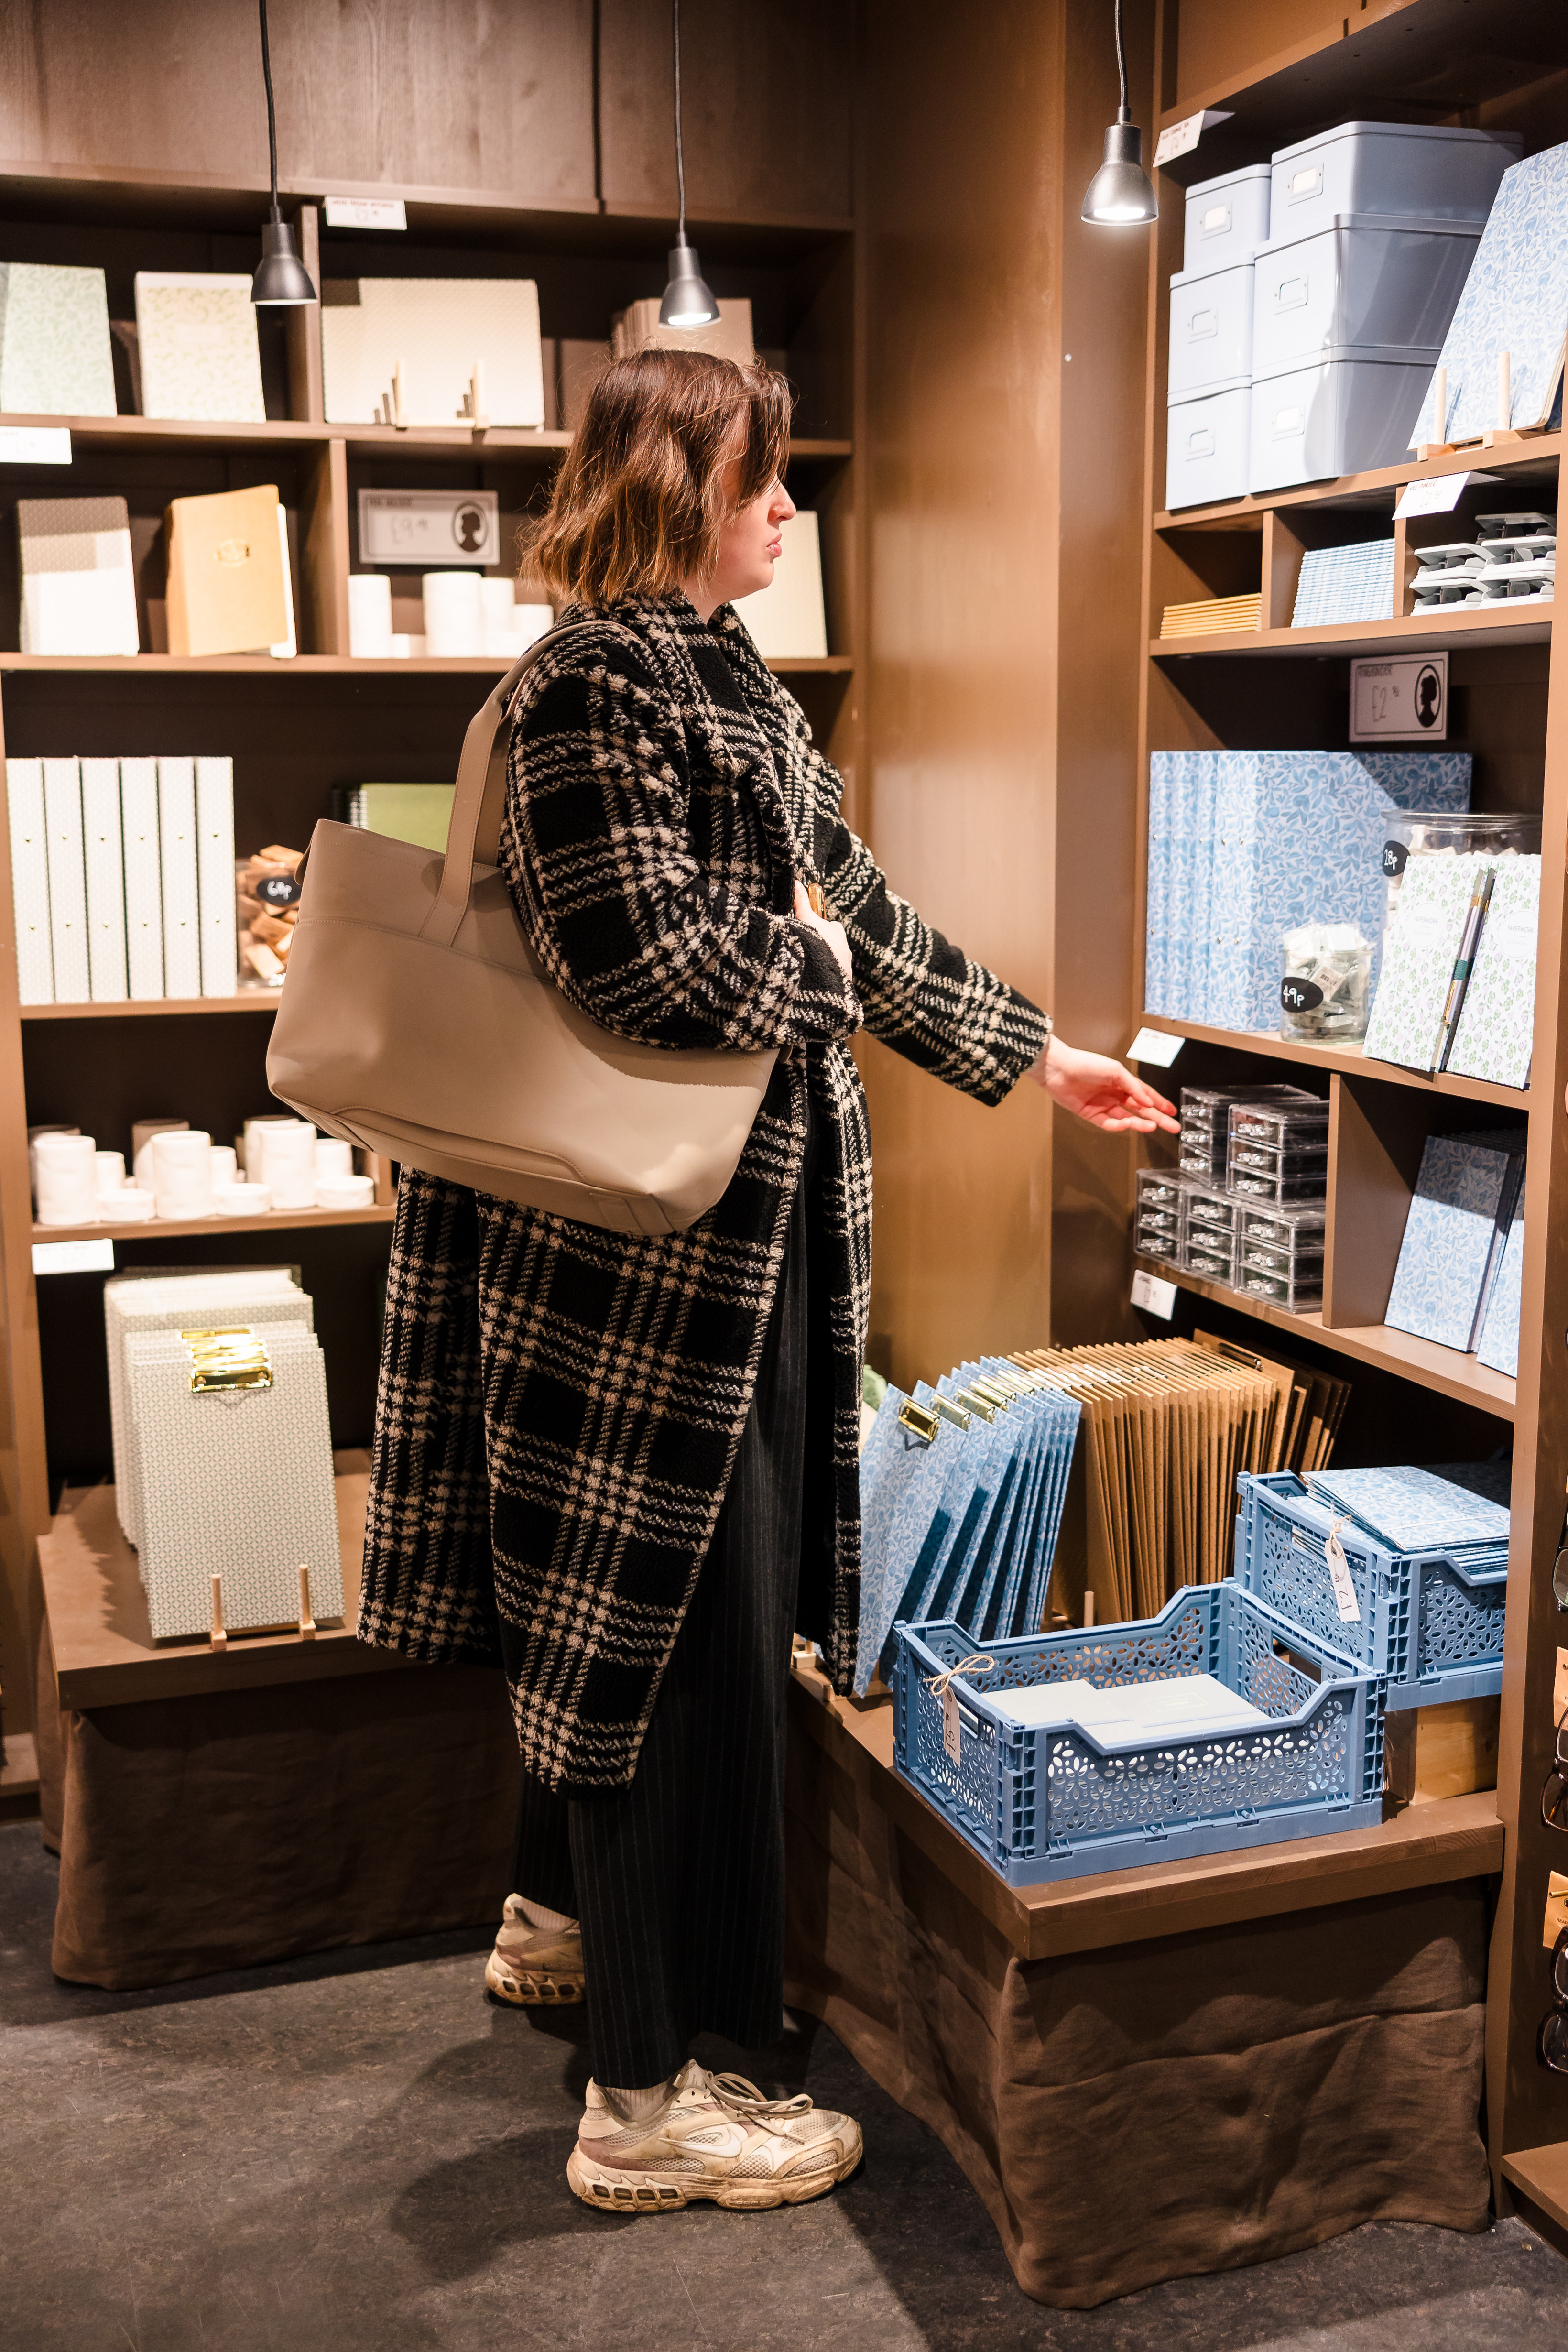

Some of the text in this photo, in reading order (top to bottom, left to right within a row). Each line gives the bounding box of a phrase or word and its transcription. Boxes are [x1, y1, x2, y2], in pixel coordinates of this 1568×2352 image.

[1414, 916, 1438, 924] PAPERWORK
[1508, 925, 1534, 934] PAPERWORK
[1283, 985, 1305, 1007] 49p
